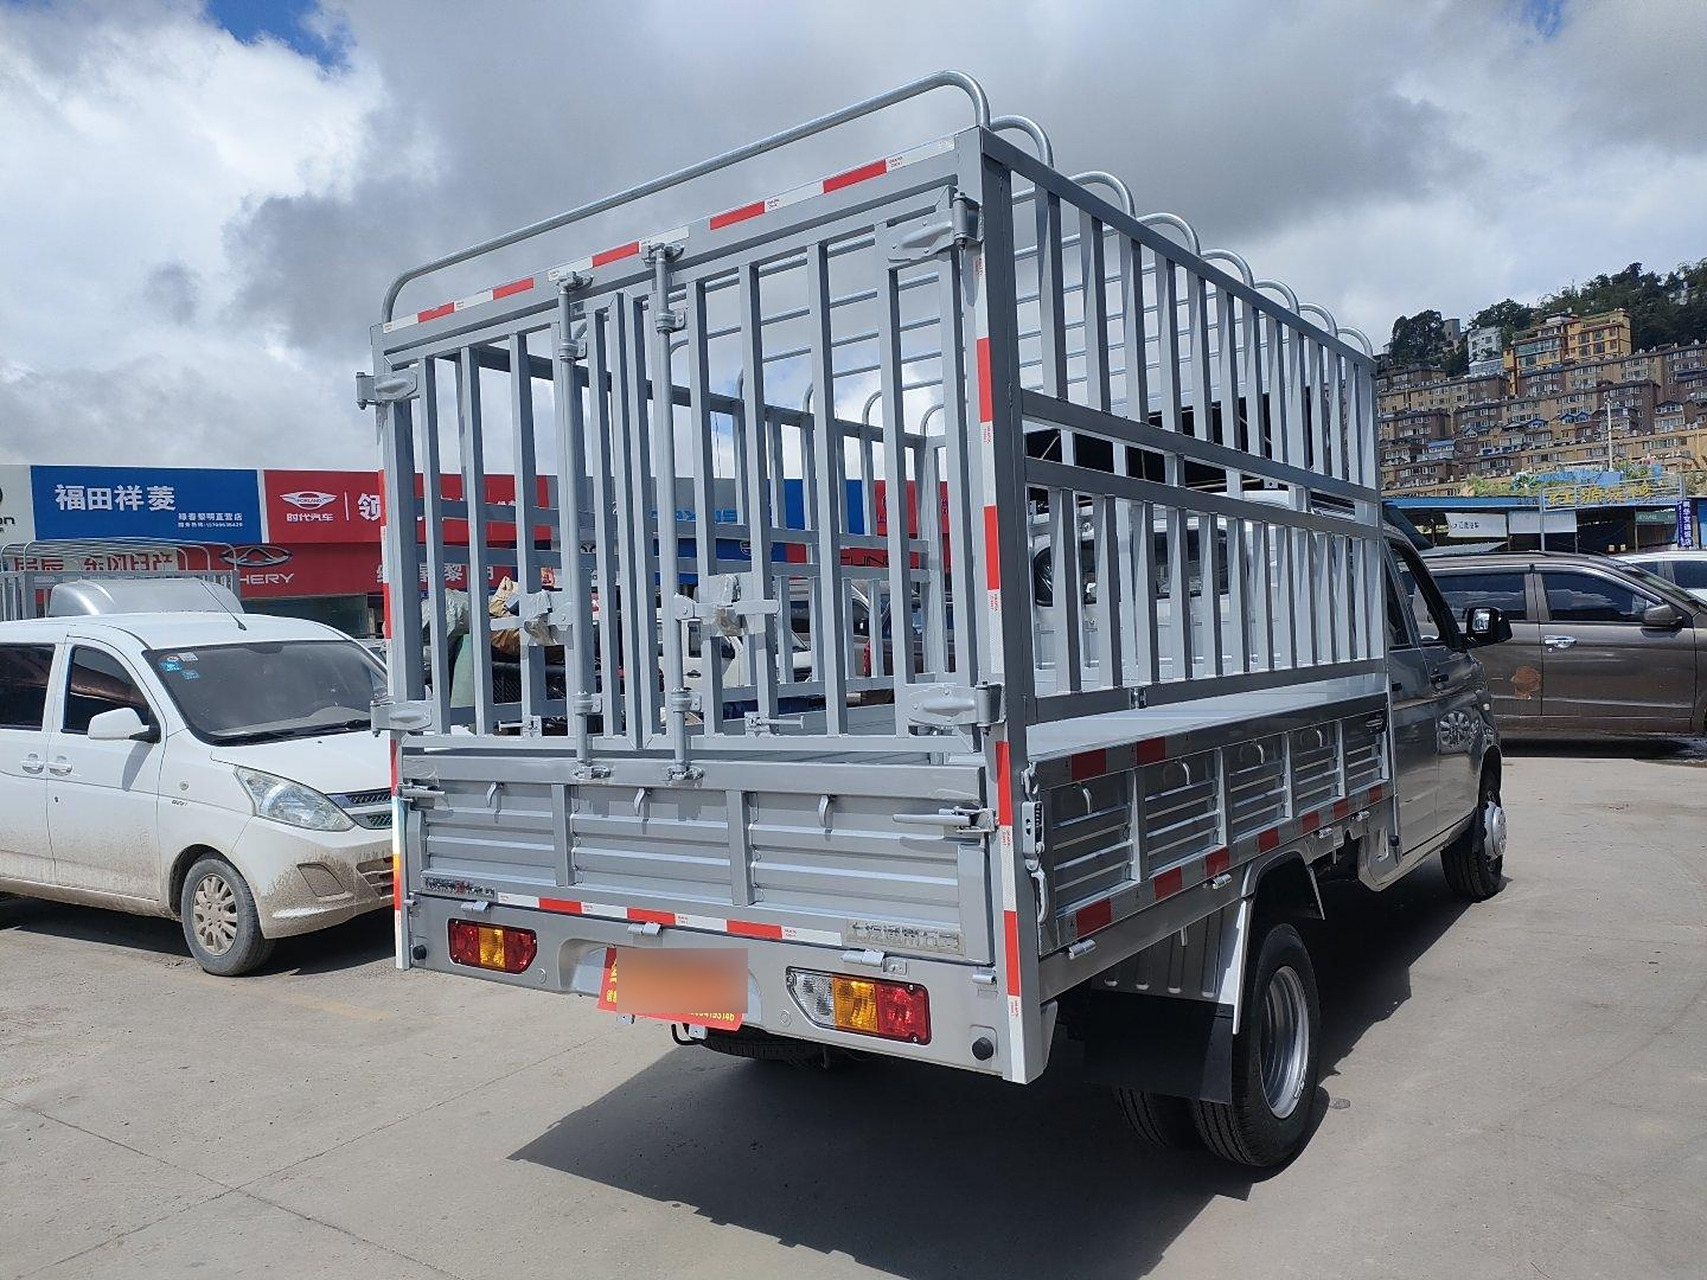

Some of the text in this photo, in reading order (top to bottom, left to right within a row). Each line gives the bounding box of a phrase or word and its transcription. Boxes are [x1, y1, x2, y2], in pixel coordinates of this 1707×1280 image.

[55, 484, 176, 511] 福田祥菱
[286, 513, 334, 522] 时代汽车
[240, 573, 295, 585] HERY
